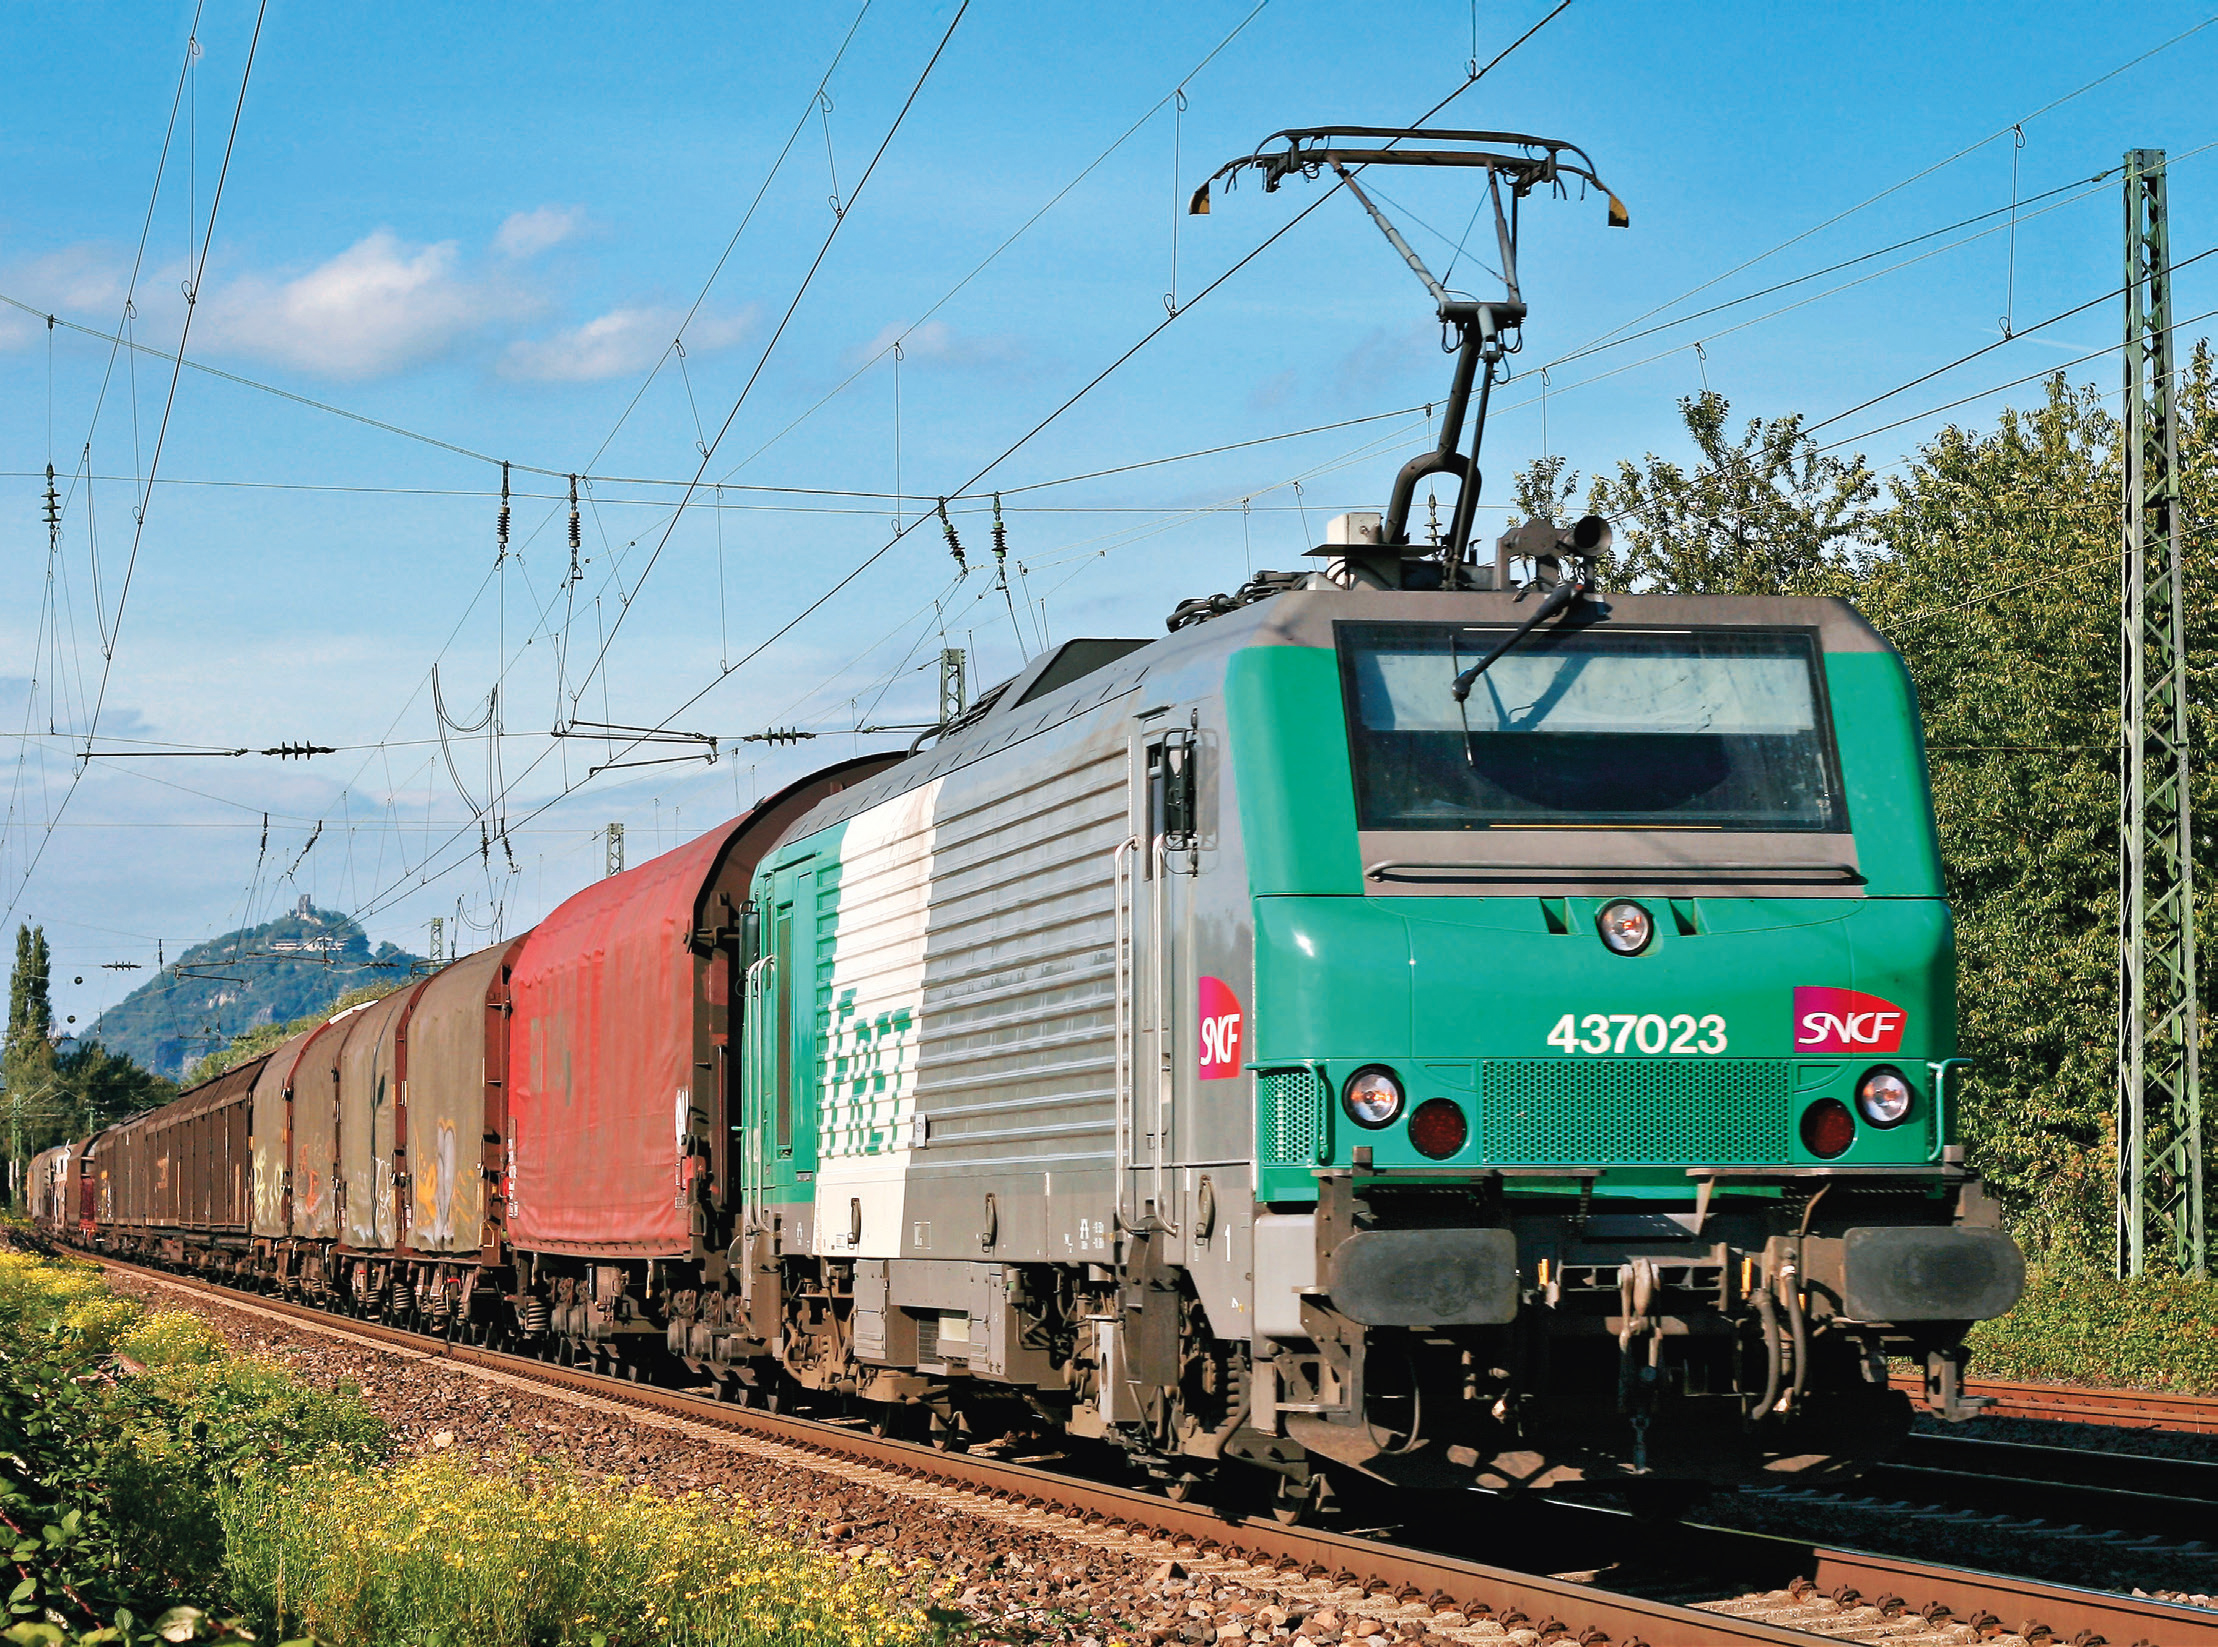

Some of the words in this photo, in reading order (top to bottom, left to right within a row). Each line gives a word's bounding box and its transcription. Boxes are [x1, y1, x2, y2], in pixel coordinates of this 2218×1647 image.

[1200, 1013, 1240, 1066] SNCF
[1547, 1014, 1728, 1054] 437023
[1798, 1012, 1901, 1045] SNCF
